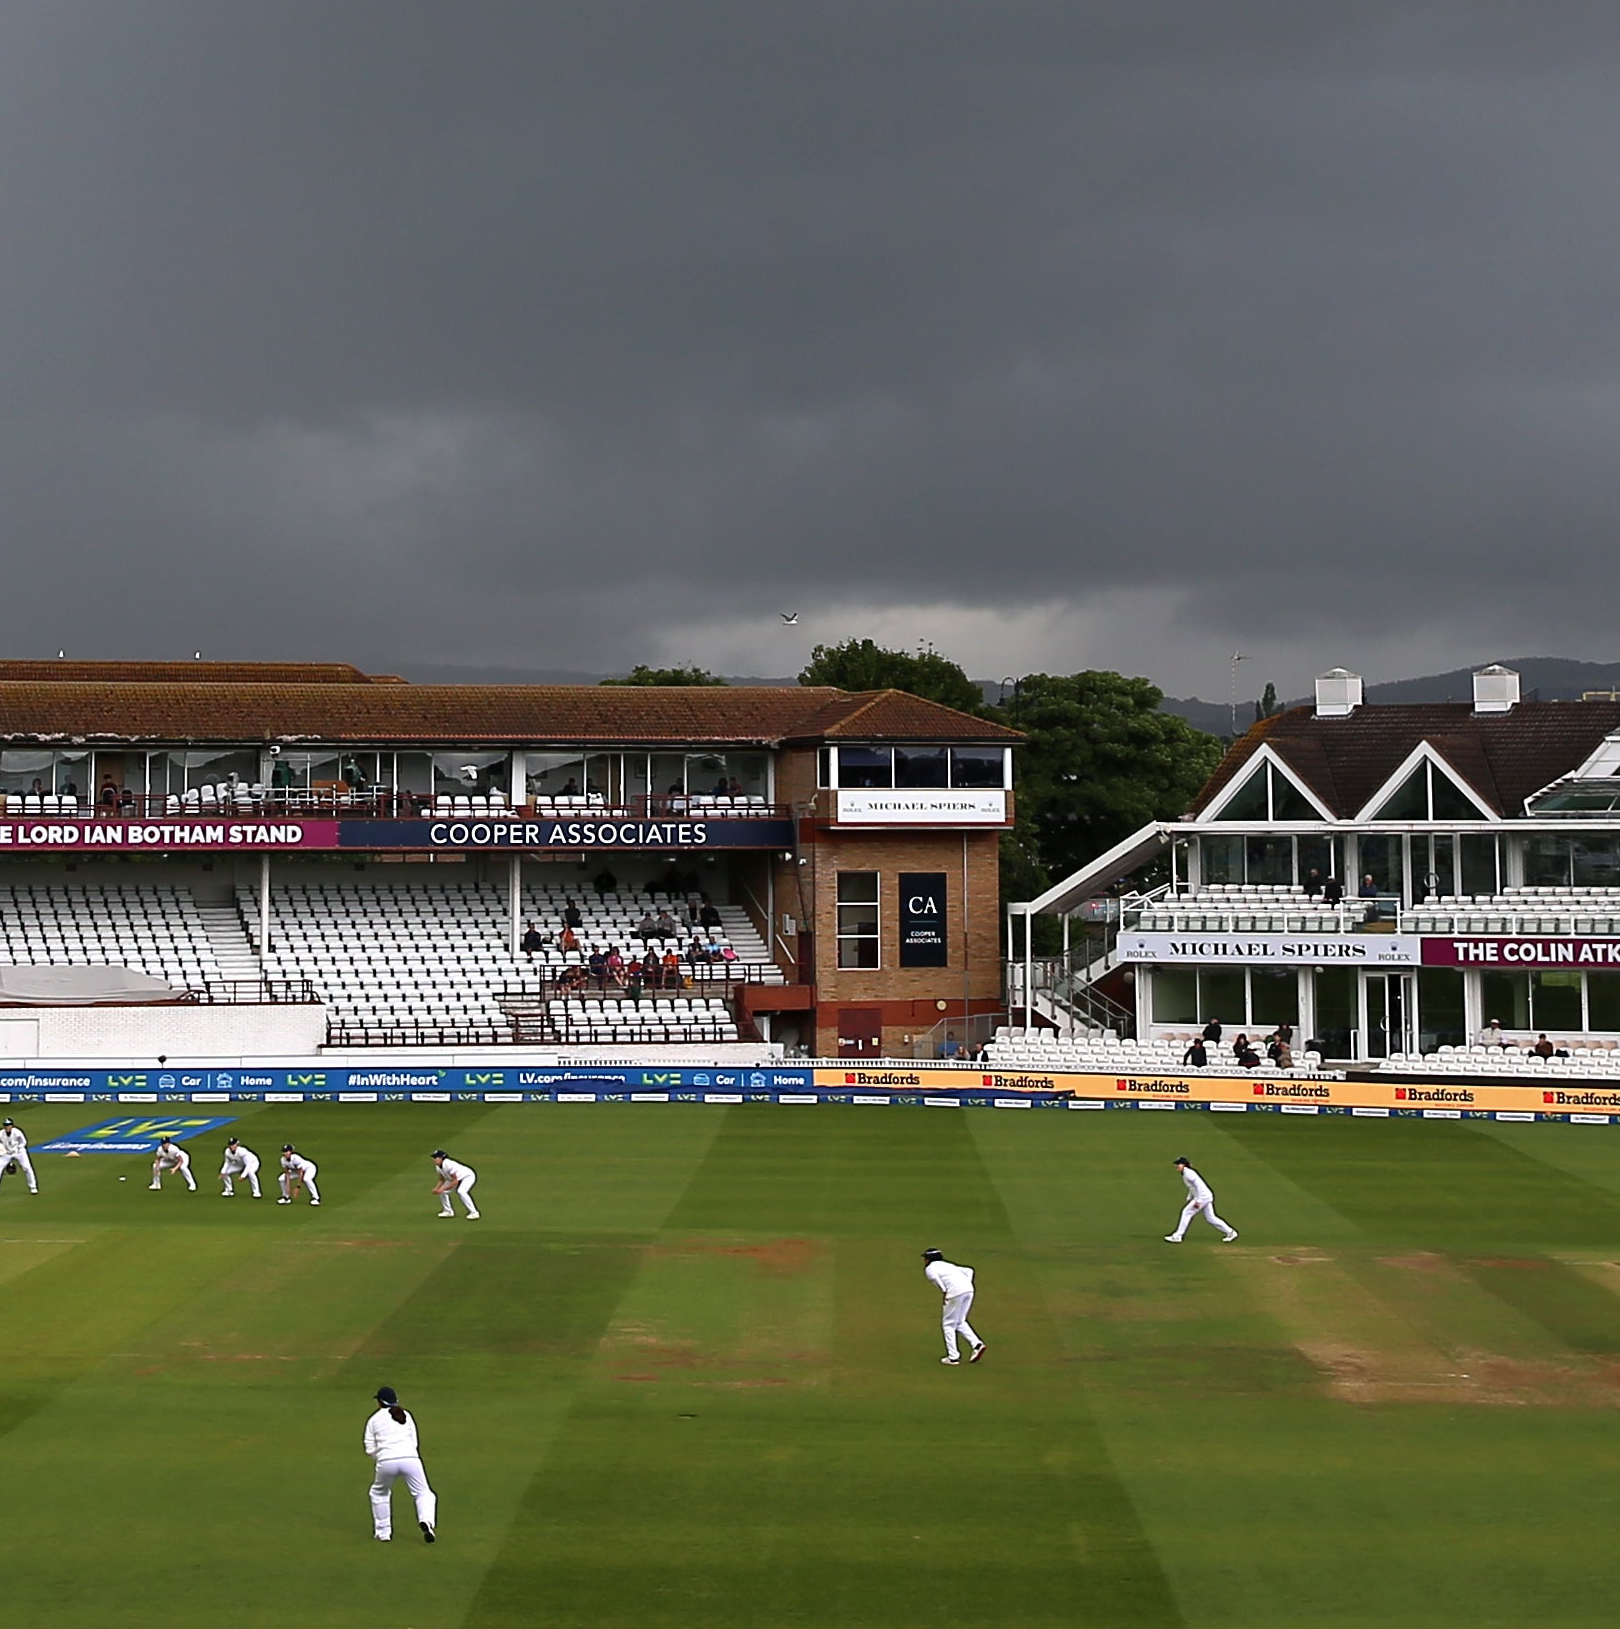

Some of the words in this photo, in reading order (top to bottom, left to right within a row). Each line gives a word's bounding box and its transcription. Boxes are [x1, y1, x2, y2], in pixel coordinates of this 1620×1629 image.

[18, 826, 79, 844] LORD
[84, 826, 122, 844] IAN
[128, 826, 223, 844] BOTHAM
[229, 826, 302, 844] STAND
[431, 824, 539, 843] COOPER
[549, 824, 706, 843] ASSOCIATES
[909, 896, 938, 914] CA
[1127, 950, 1157, 958] ROLEX
[1169, 942, 1275, 956] MICHAEL
[1282, 943, 1366, 956] SPIERS
[1454, 942, 1498, 961] THE
[1504, 943, 1573, 962] COLIN
[182, 1076, 202, 1086] Car
[241, 1076, 273, 1086] Home
[348, 1073, 438, 1085] #InWithHeart
[716, 1075, 735, 1085] Car
[774, 1075, 805, 1085] Home
[857, 1073, 920, 1085] Bradfords
[994, 1075, 1055, 1089] Bradfords
[1129, 1080, 1190, 1094] Bradfords
[1266, 1084, 1330, 1098] Bradfords
[1408, 1088, 1474, 1103] Bradfords
